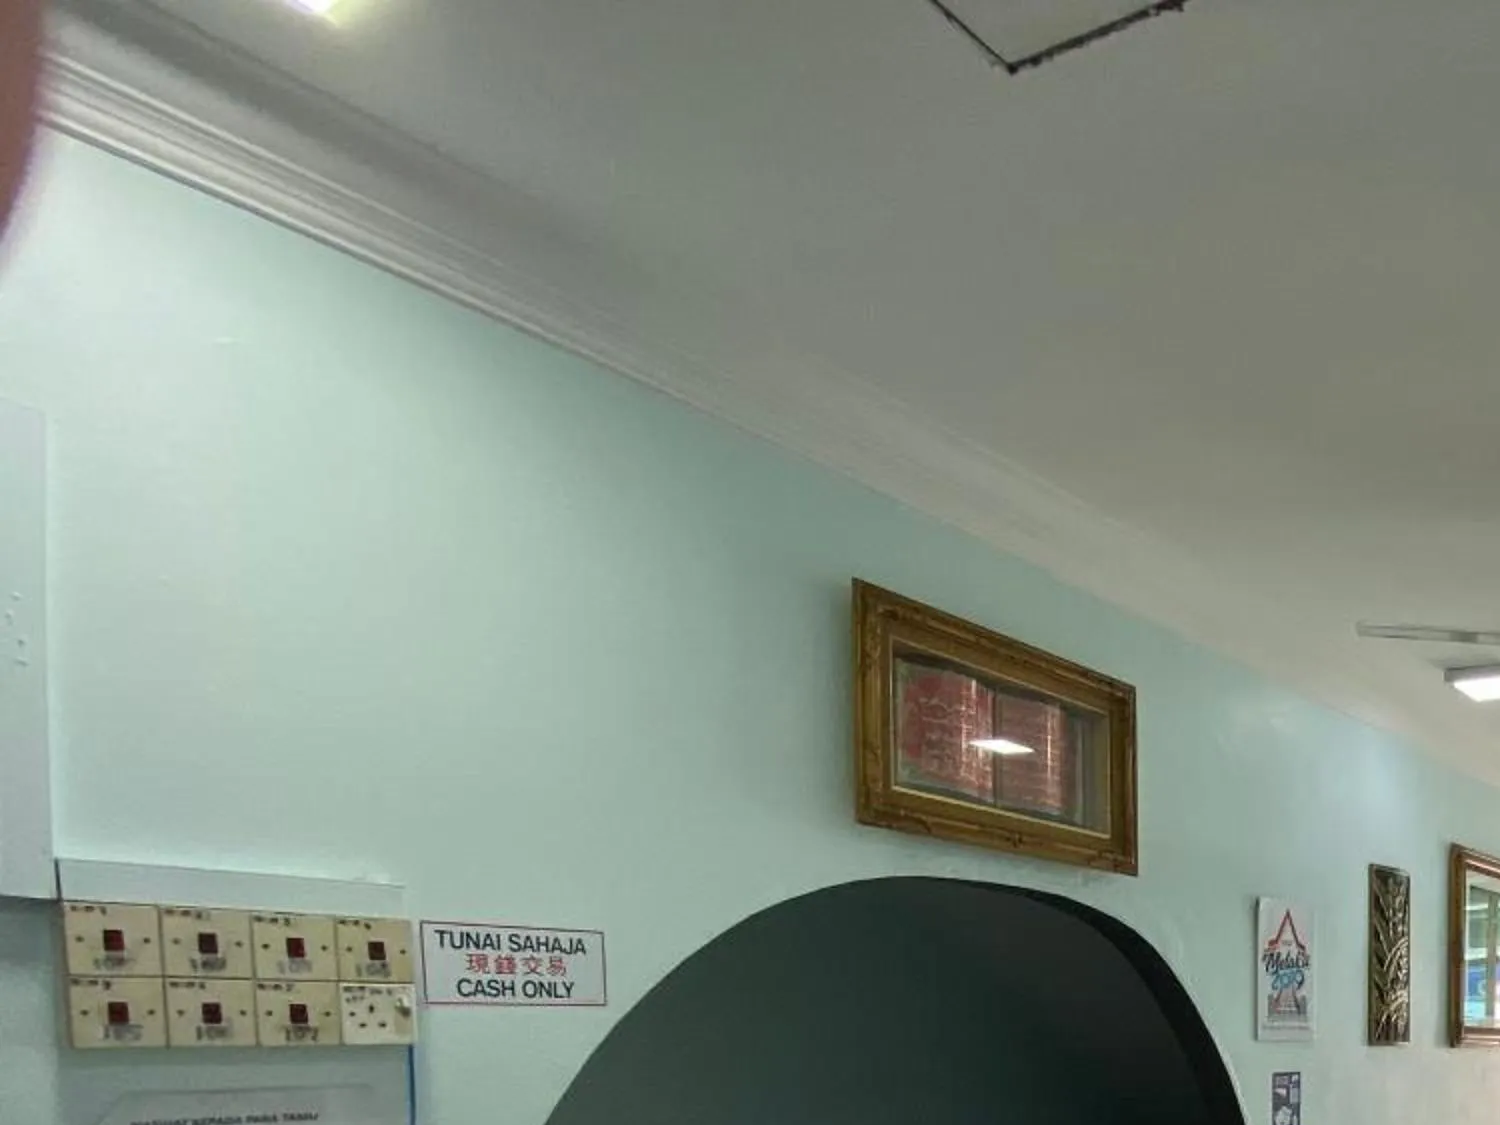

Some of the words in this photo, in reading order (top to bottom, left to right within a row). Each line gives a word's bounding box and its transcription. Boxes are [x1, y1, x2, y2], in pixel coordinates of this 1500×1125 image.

[434, 929, 501, 950] TUNAI
[508, 933, 586, 955] SAHAJA
[457, 978, 515, 997] CASH
[522, 980, 574, 999] ONLY
